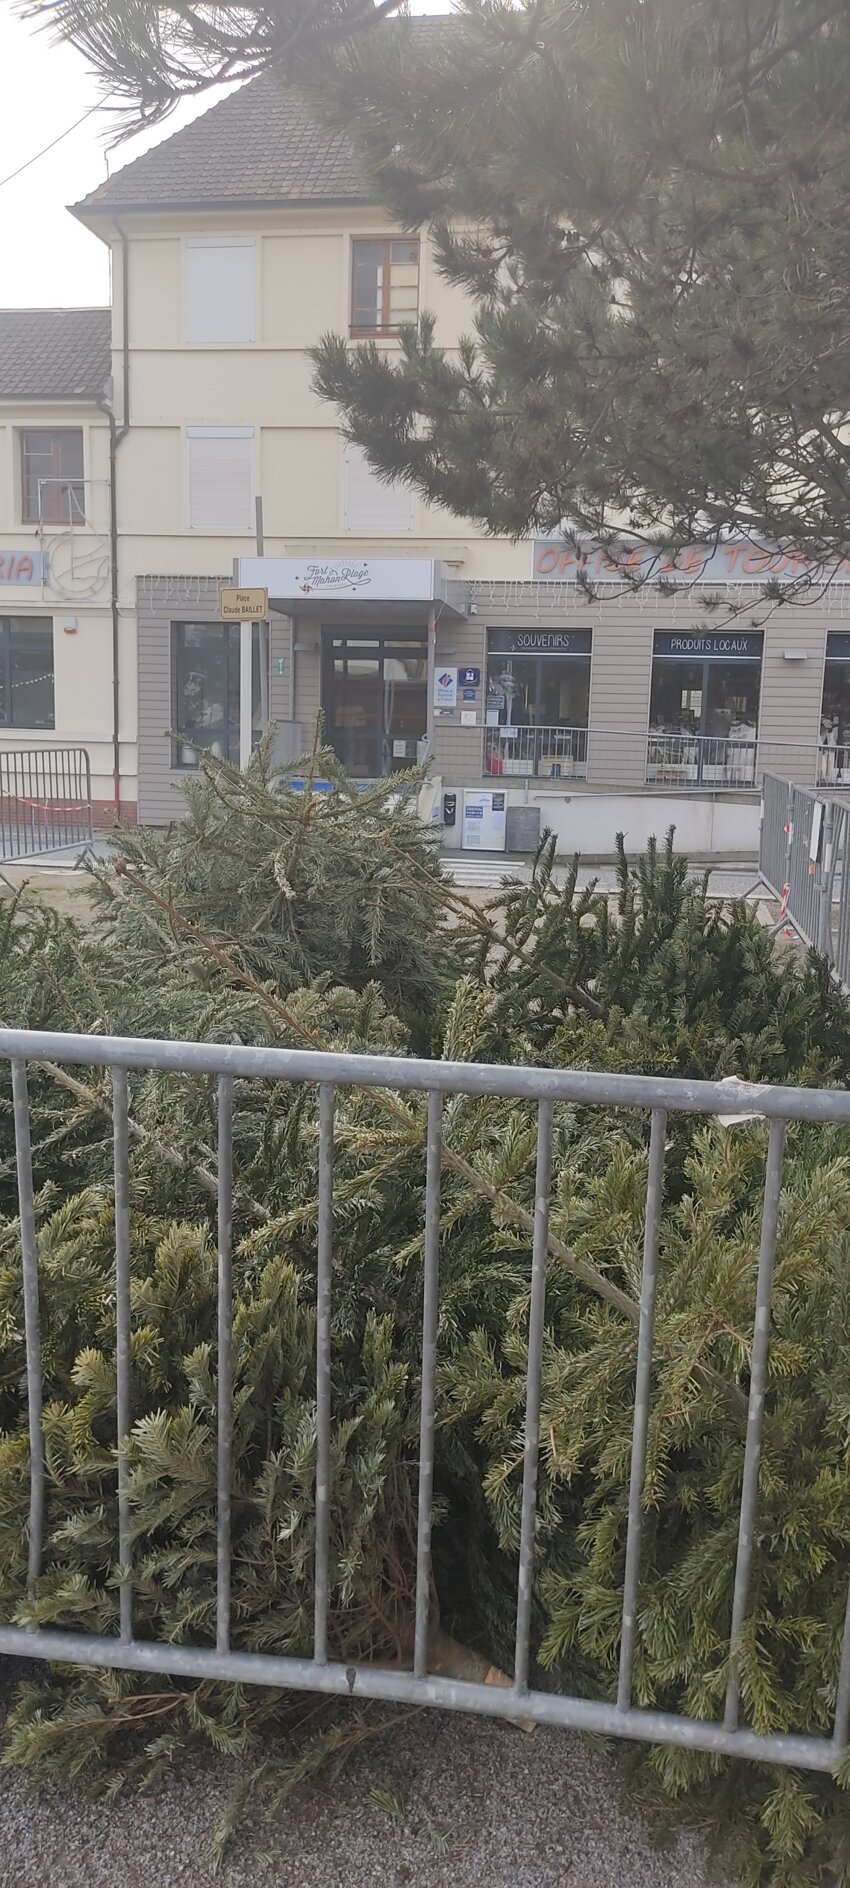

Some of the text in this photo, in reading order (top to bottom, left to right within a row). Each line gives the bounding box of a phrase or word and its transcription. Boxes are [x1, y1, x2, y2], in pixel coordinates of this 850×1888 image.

[304, 565, 370, 583] Fort Plage
[236, 594, 250, 602] Place
[223, 605, 263, 614] Claude BAILLET
[517, 633, 570, 647] SOUVENIRS
[670, 638, 748, 651] PRODUITS LOCAUX
